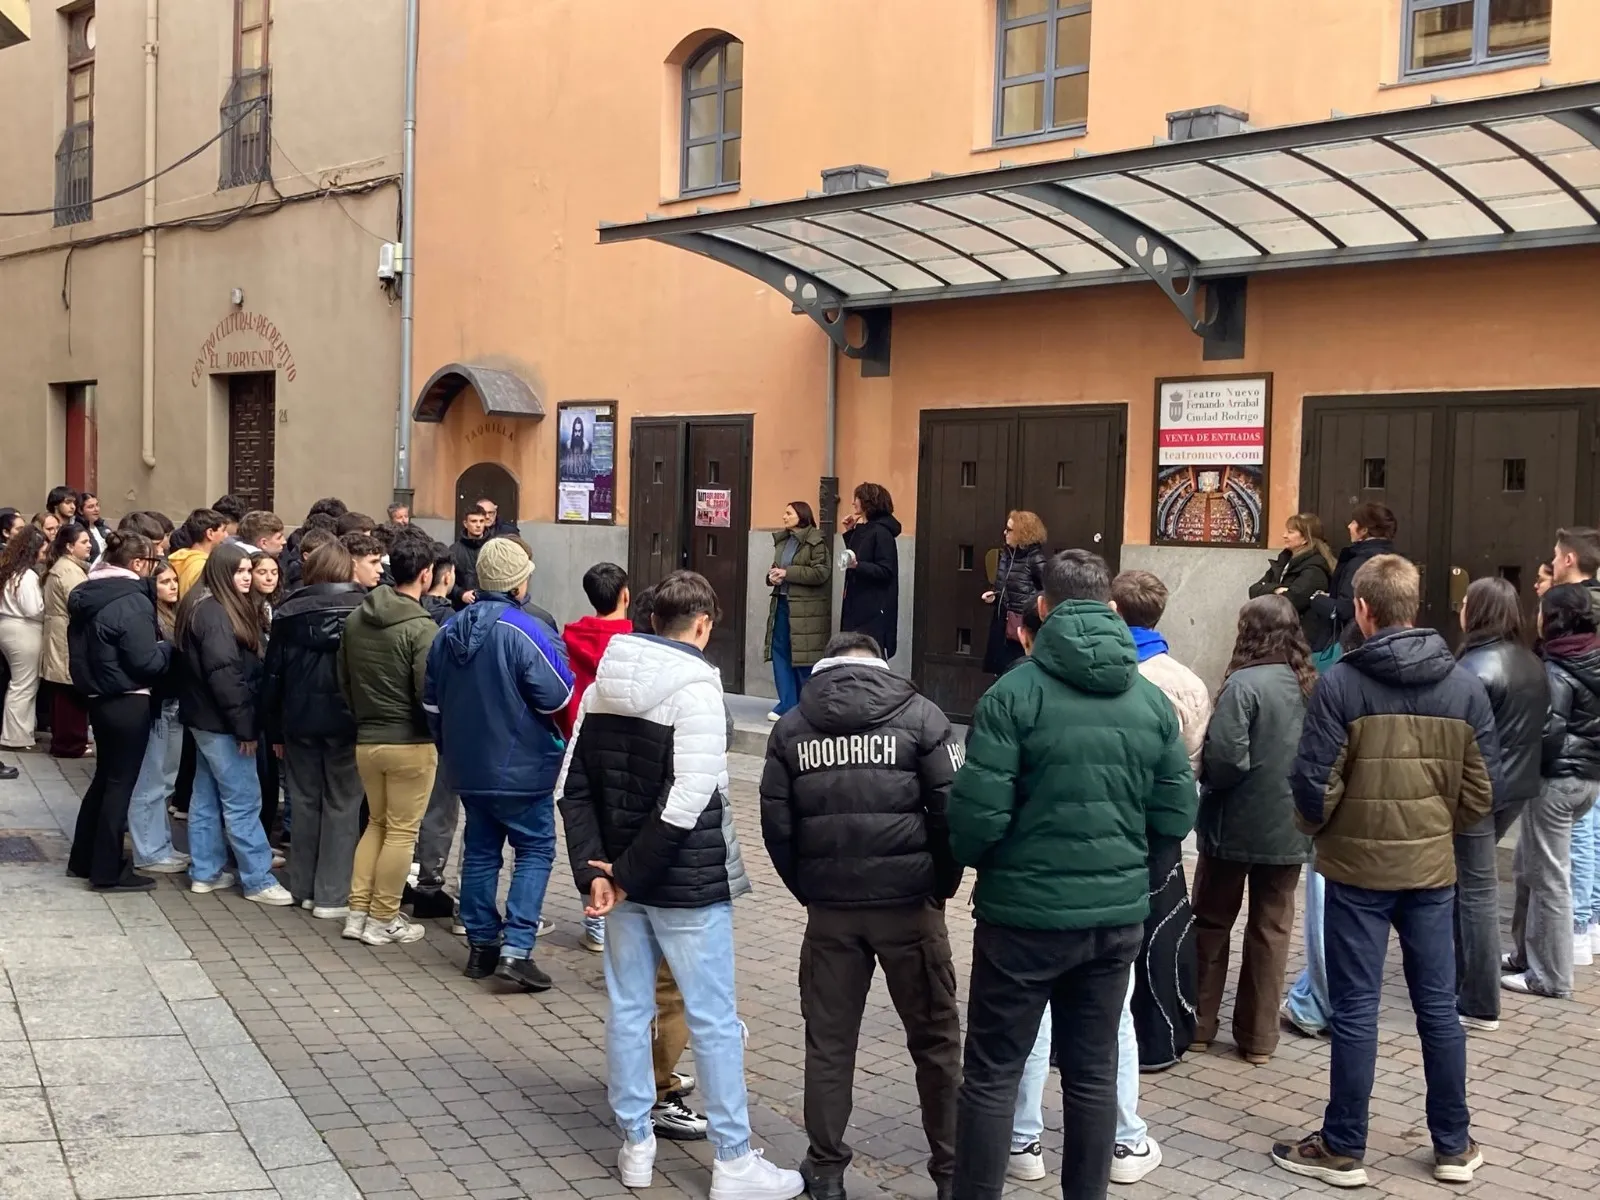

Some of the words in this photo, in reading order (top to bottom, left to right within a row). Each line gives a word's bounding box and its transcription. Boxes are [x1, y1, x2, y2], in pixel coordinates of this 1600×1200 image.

[191, 332, 216, 388] CENTRO
[215, 311, 254, 342] CULTURAL
[209, 352, 221, 369] EL
[226, 349, 275, 369] PORVENIR
[1186, 388, 1221, 399] Teatro
[1227, 387, 1260, 397] Nuevo
[1186, 399, 1225, 409] Fernando
[1228, 398, 1259, 408] Arrabal
[1186, 411, 1218, 422] Ciudad
[1221, 410, 1259, 423] Rodrigo
[465, 423, 514, 443] TAQUILLA
[1165, 433, 1196, 443] VENTA
[1196, 432, 1210, 442] DE
[1211, 431, 1261, 442] ENTRADAS
[1164, 450, 1260, 460] teatronuevo.com
[797, 734, 897, 772] HOODRICH
